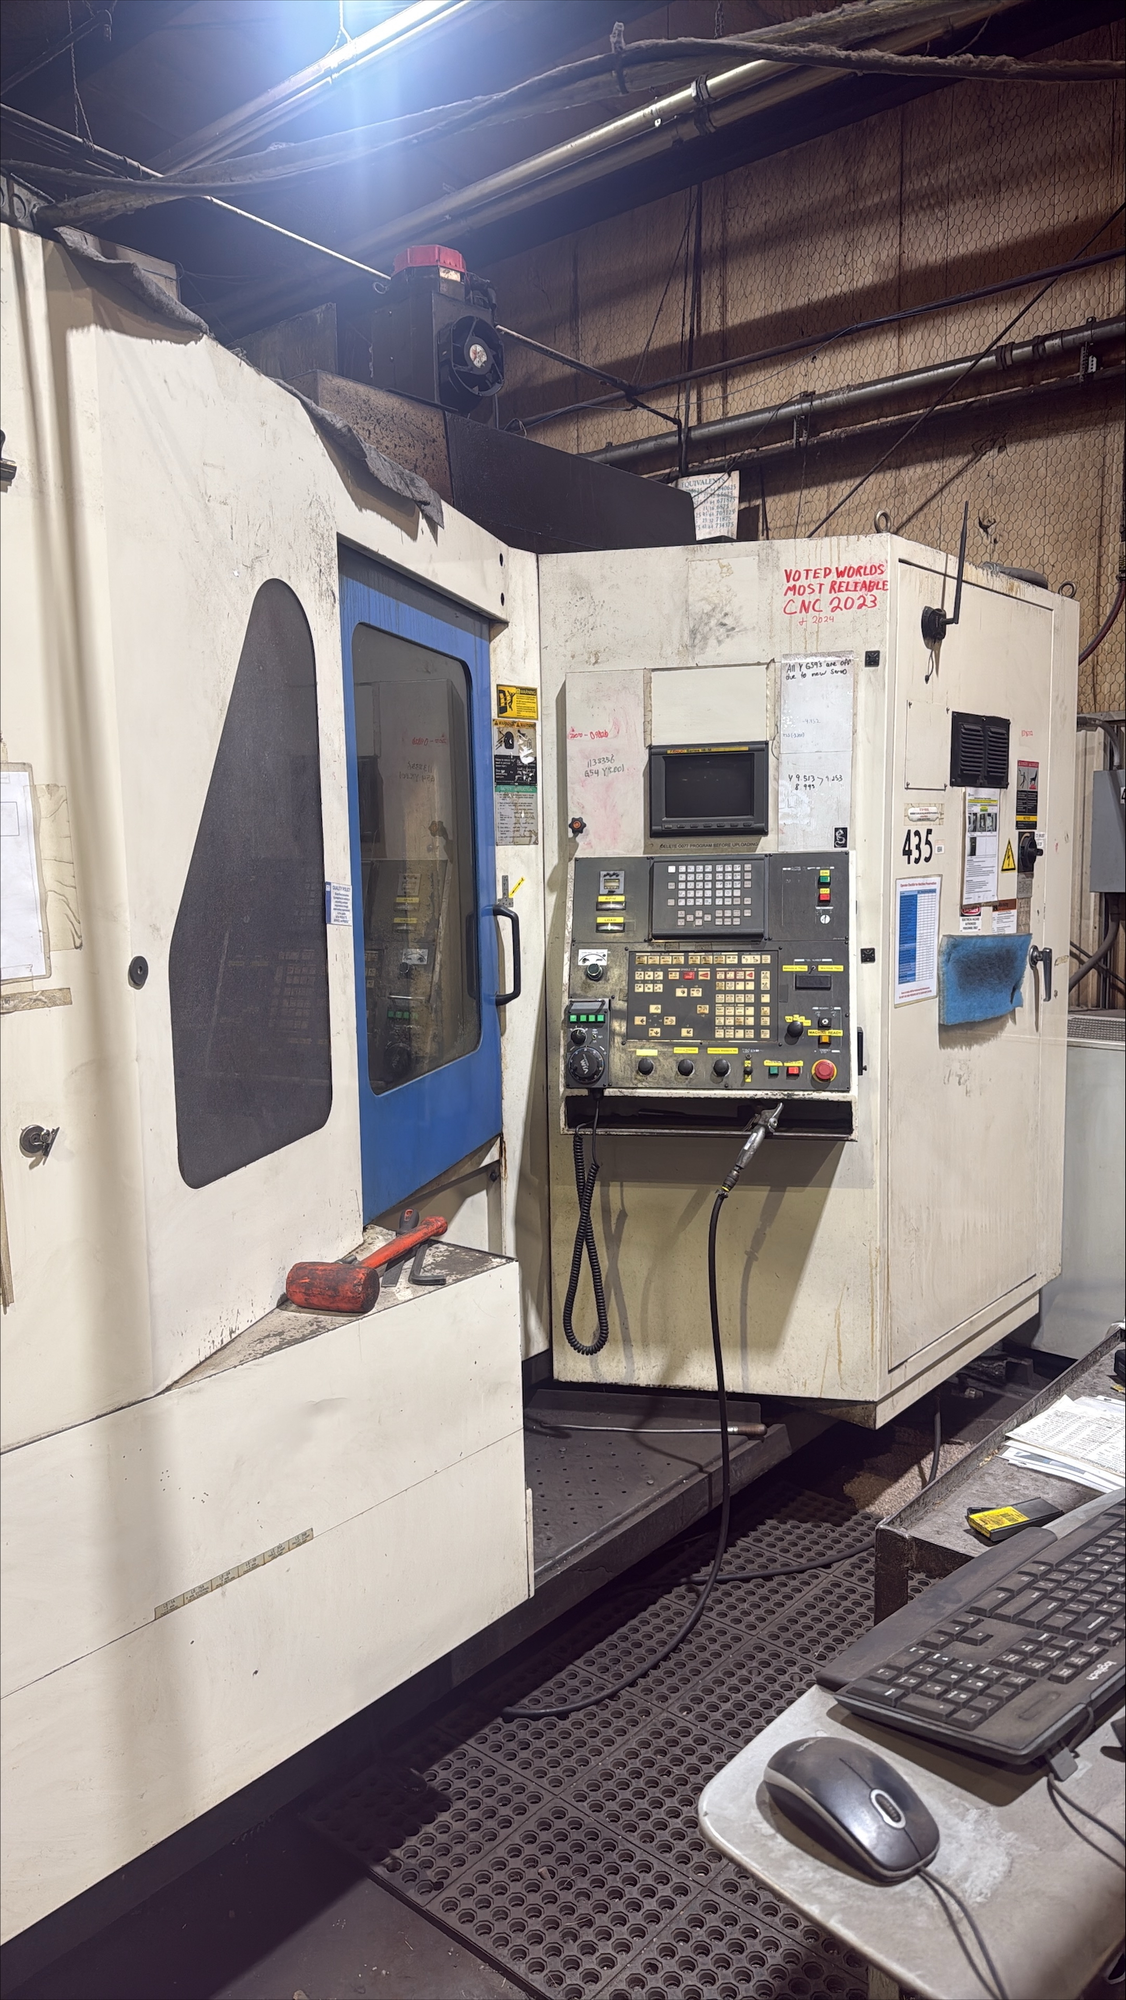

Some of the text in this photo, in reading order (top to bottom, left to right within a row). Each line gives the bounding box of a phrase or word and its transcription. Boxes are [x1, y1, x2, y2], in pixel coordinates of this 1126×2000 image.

[784, 567, 832, 583] VOTED
[784, 580, 889, 596] MOST RELIABLE
[783, 594, 878, 615] CNC 2023
[812, 615, 835, 624] 2024
[902, 828, 933, 865] 435
